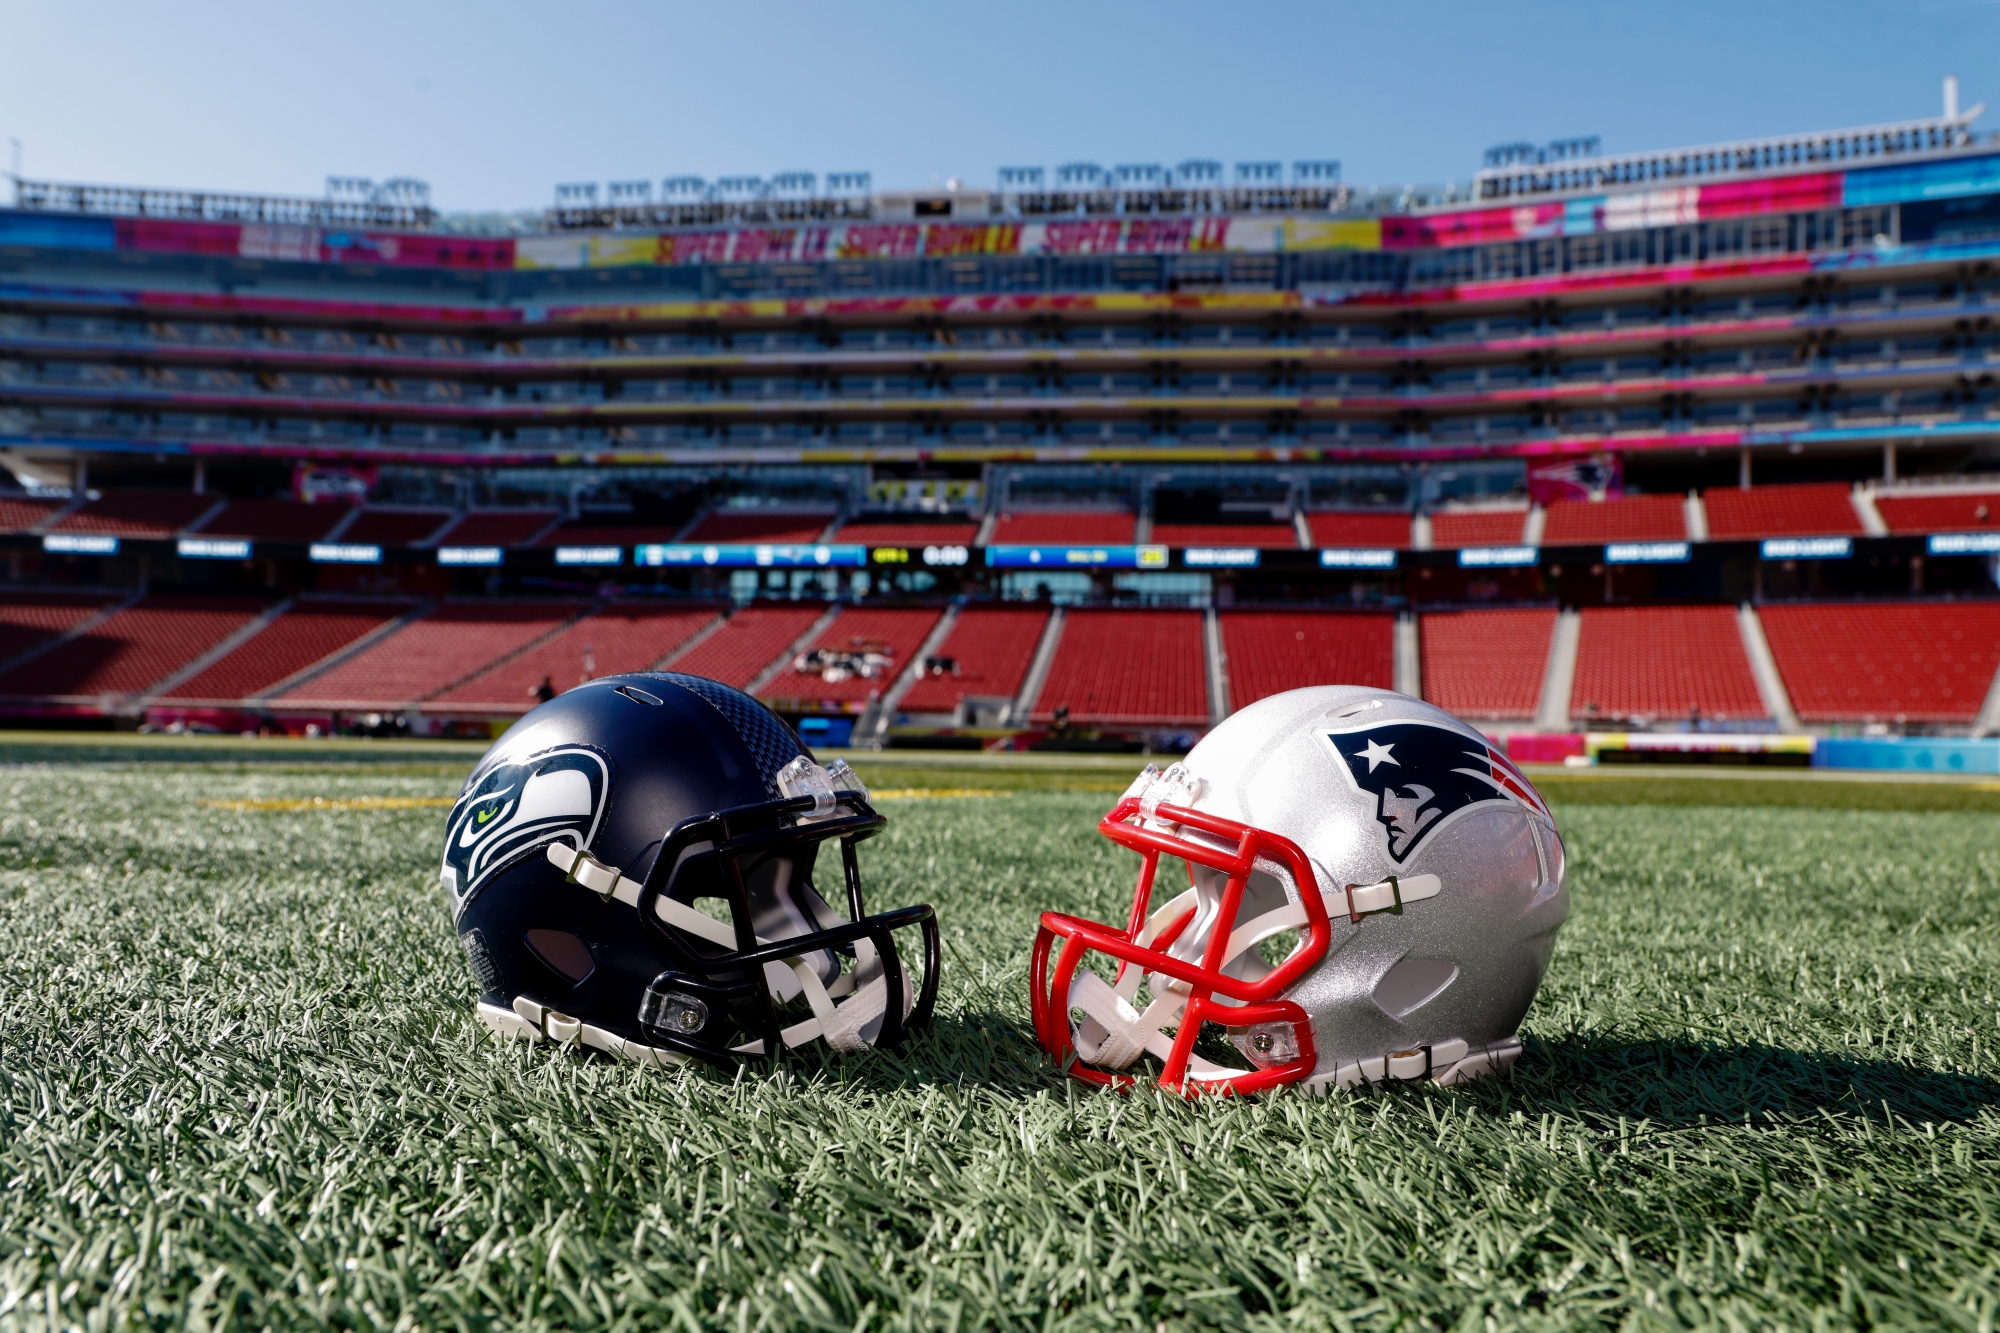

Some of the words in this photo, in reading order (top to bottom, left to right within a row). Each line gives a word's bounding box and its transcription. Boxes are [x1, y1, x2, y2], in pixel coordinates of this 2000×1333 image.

[843, 224, 921, 259] SUPER
[924, 223, 989, 257] BOWL
[1043, 220, 1122, 254] SUPER
[1127, 219, 1194, 254] BOWL
[655, 231, 729, 264] SUPER
[733, 228, 797, 262] BOWL
[1608, 544, 1641, 561] BUD
[1643, 543, 1687, 560] LIGHT
[1765, 540, 1799, 556] BUD
[1801, 538, 1848, 555] LIGHT
[1932, 535, 1967, 552] BUD
[1462, 548, 1493, 564] BUD
[1494, 547, 1536, 563] LIGHT
